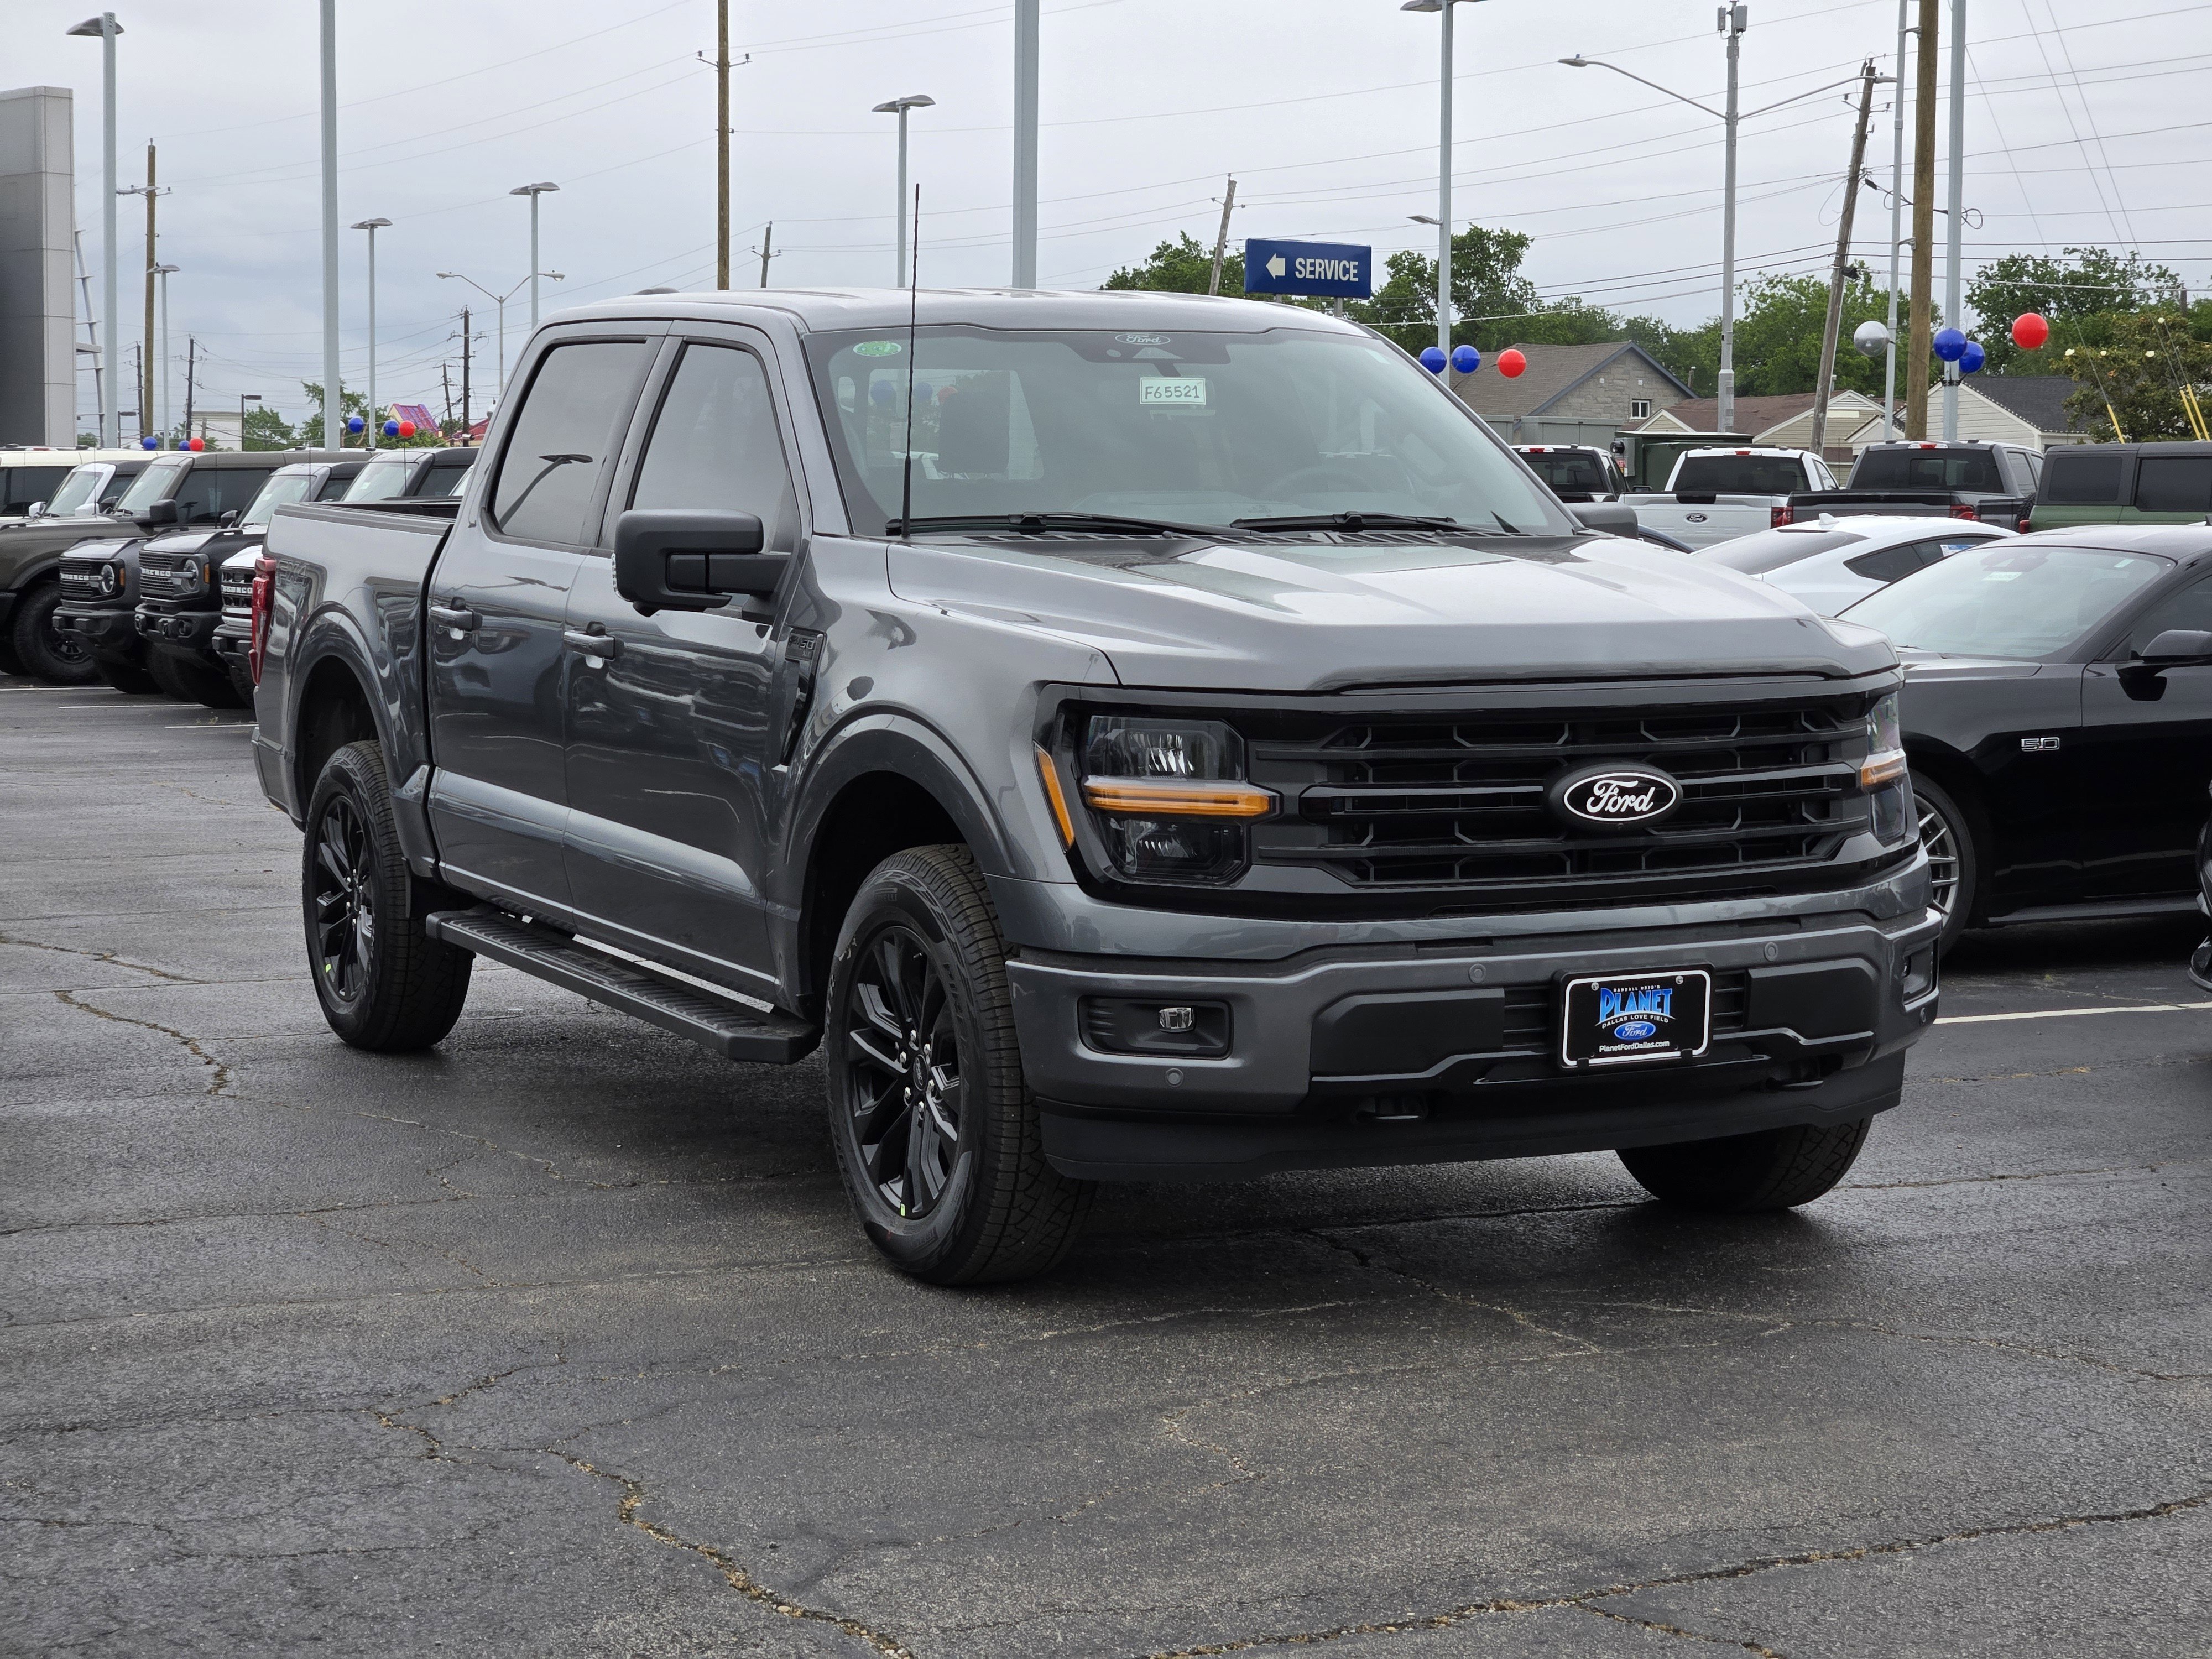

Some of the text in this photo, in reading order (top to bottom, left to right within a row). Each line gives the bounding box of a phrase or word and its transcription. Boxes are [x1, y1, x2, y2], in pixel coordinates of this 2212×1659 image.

[1295, 257, 1359, 282] SERVICE
[1126, 333, 1162, 344] Ford
[1145, 384, 1200, 400] F65521
[2021, 737, 2060, 752] 5.0
[1586, 779, 1656, 813] Ford
[1599, 987, 1673, 1023] PLANET
[1601, 1016, 1628, 1029] DALLAS
[1650, 1015, 1669, 1024] FIELD
[1621, 1024, 1648, 1037] Ford
[1599, 1040, 1670, 1052] PlanetFordDallas.com
